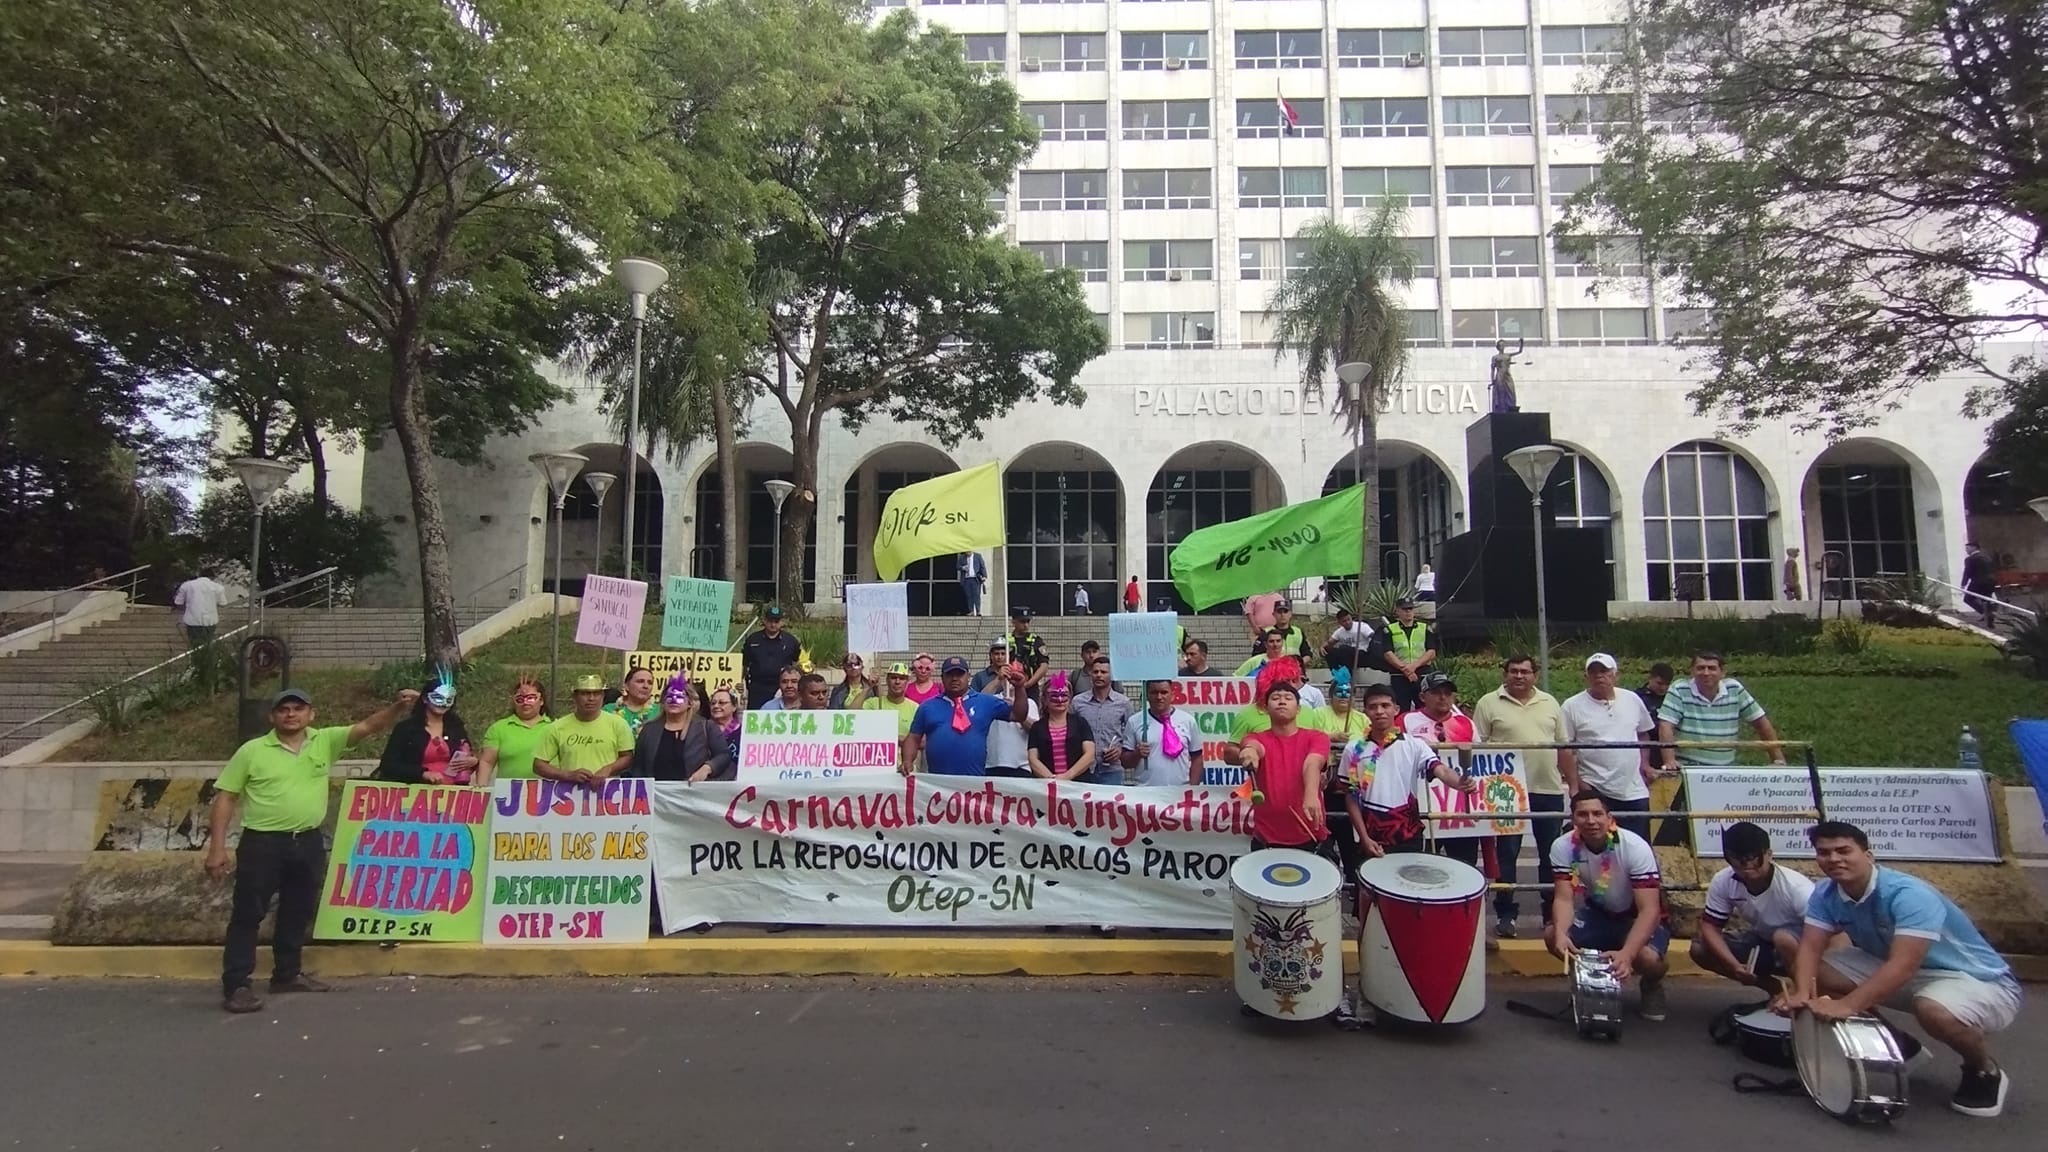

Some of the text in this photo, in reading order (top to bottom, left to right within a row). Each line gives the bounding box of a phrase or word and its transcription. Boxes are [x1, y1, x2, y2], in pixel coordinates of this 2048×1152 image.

[1134, 386, 1264, 416] PALACIO
[1279, 386, 1320, 415] DE
[945, 511, 968, 525] SN
[588, 575, 632, 598] LIBERTAD
[674, 579, 717, 598] POR UNA
[590, 596, 629, 620] SINDICAL
[670, 598, 719, 616] VERDADERA
[669, 615, 723, 633] DEMOCRACIA
[649, 655, 693, 672] ESTADO
[696, 656, 713, 672] ES
[718, 656, 732, 672] EL
[744, 712, 856, 736] BASTA DE
[744, 742, 894, 768] BUROCRACIA JUDICIAL
[1468, 752, 1515, 778] ARLOS
[1769, 775, 1782, 783] de
[1882, 775, 1968, 785] Administrativos
[494, 779, 651, 816] JUSTICIA
[724, 775, 916, 834] Carnaval
[926, 781, 1037, 828] contra
[1046, 780, 1078, 829] la
[1748, 788, 1759, 797] de
[1880, 789, 1891, 797] la
[348, 785, 491, 825] EDUCACION
[1889, 804, 1899, 813] la
[1902, 804, 1932, 813] OTEP
[1787, 828, 1800, 836] de
[1890, 829, 1904, 838] de
[1906, 829, 1917, 838] la
[1901, 817, 1936, 827] Carlos
[1938, 817, 1977, 827] Parodi
[356, 829, 460, 860] PARA LA
[494, 824, 649, 861] PARA LOS MÁS
[1786, 840, 1802, 849] del
[690, 840, 743, 876] POR
[753, 839, 786, 869] LA
[795, 839, 959, 871] REPOSICION
[970, 841, 1006, 869] DE
[1020, 843, 1131, 875] CARLOS
[329, 863, 474, 914] LIBERTAD
[492, 874, 644, 905] DESPROTEGIDOS
